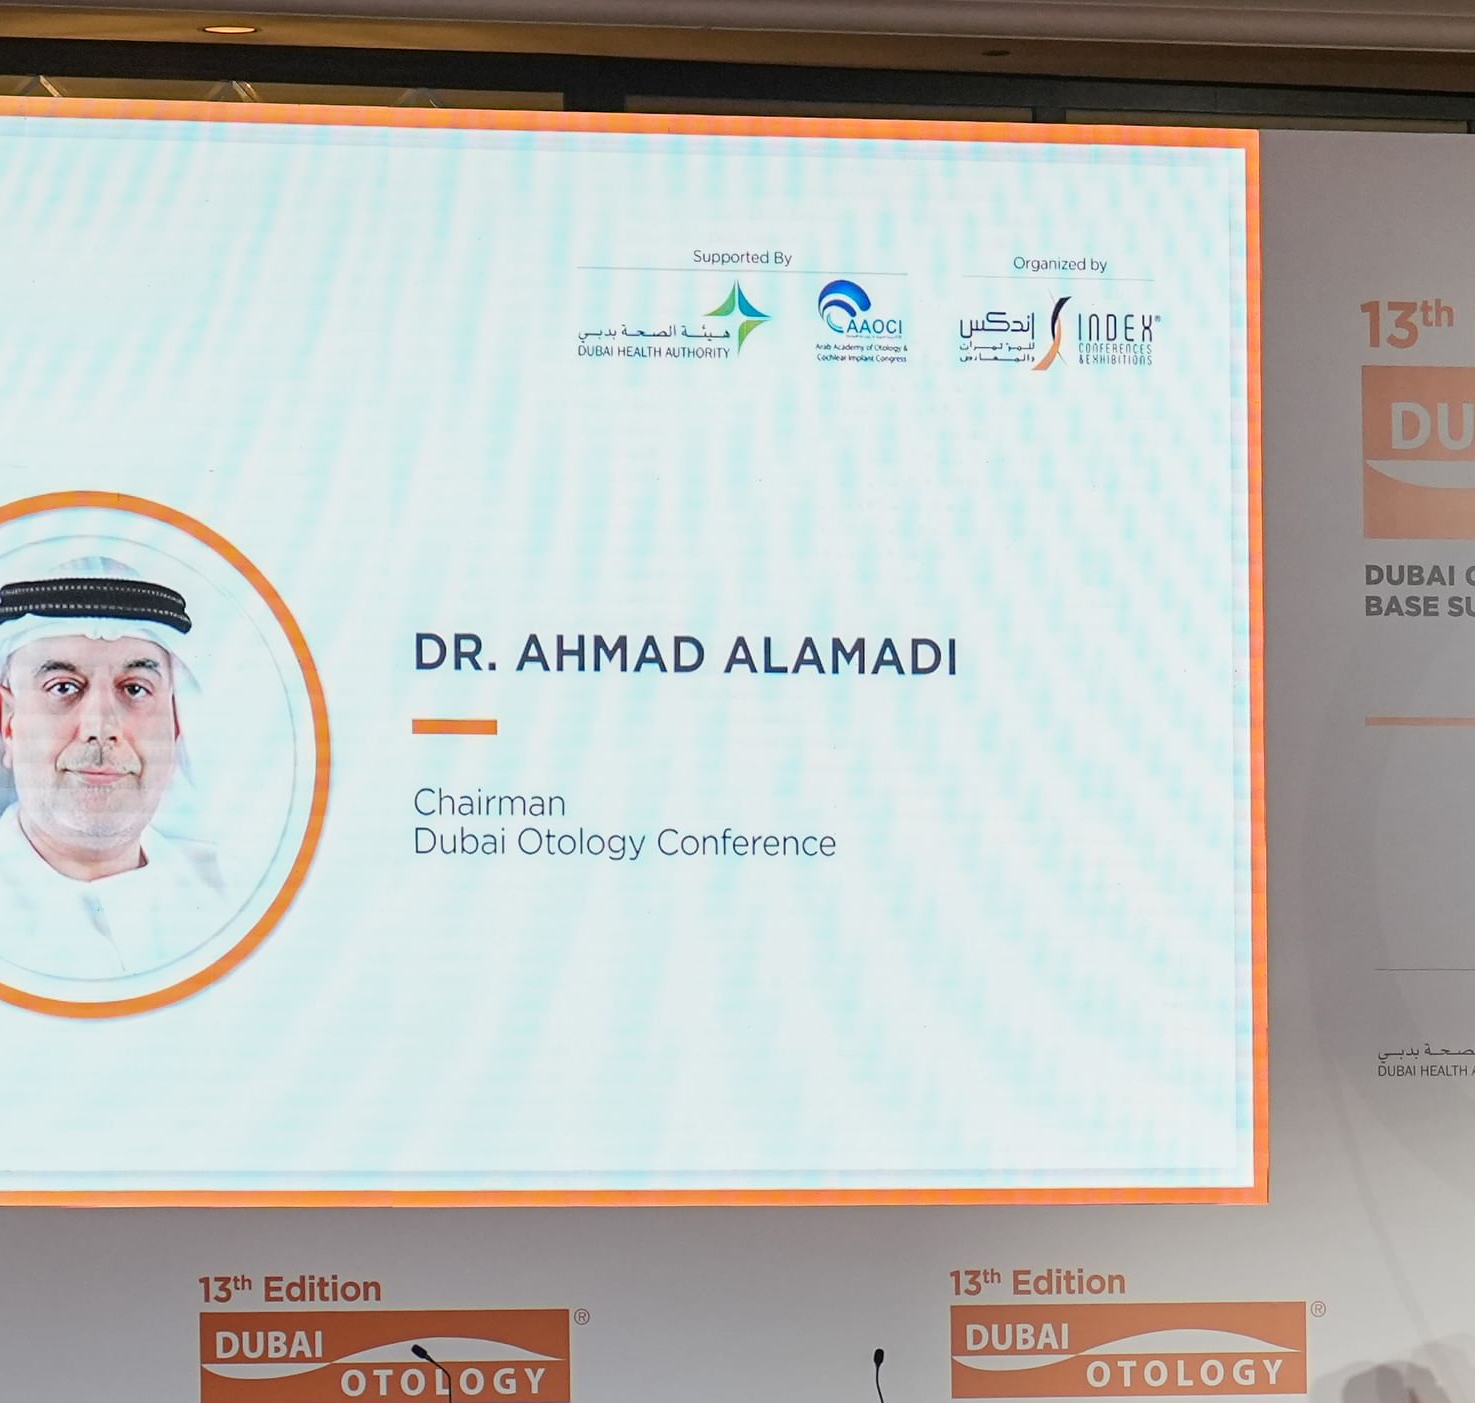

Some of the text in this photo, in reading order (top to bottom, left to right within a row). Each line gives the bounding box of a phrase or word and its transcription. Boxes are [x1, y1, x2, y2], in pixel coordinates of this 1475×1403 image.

[694, 250, 792, 266] Supported By
[1014, 257, 1107, 273] Organized by
[847, 319, 902, 335] AAOCI
[1360, 299, 1453, 350] 13th
[578, 346, 730, 359] DUBAI HEALTH AUTHORITY
[1079, 344, 1152, 354] CONFERENCES
[1365, 566, 1455, 586] DUBAI
[1365, 596, 1439, 617] BASE
[415, 633, 956, 675] DR. AHMAD ALAMADI
[414, 788, 565, 816] Chairman
[414, 827, 836, 860] Dubai Otology Conference
[1378, 1066, 1416, 1077] DUBAI
[1421, 1066, 1467, 1076] HEALTH
[199, 1275, 381, 1304] 13th Edition
[949, 1268, 1125, 1296] 13th Edition
[215, 1330, 323, 1360] DUBAI
[966, 1322, 1068, 1351] DUBAI
[340, 1367, 545, 1397] OTOLOGY
[1086, 1357, 1283, 1389] OTOLOGY
